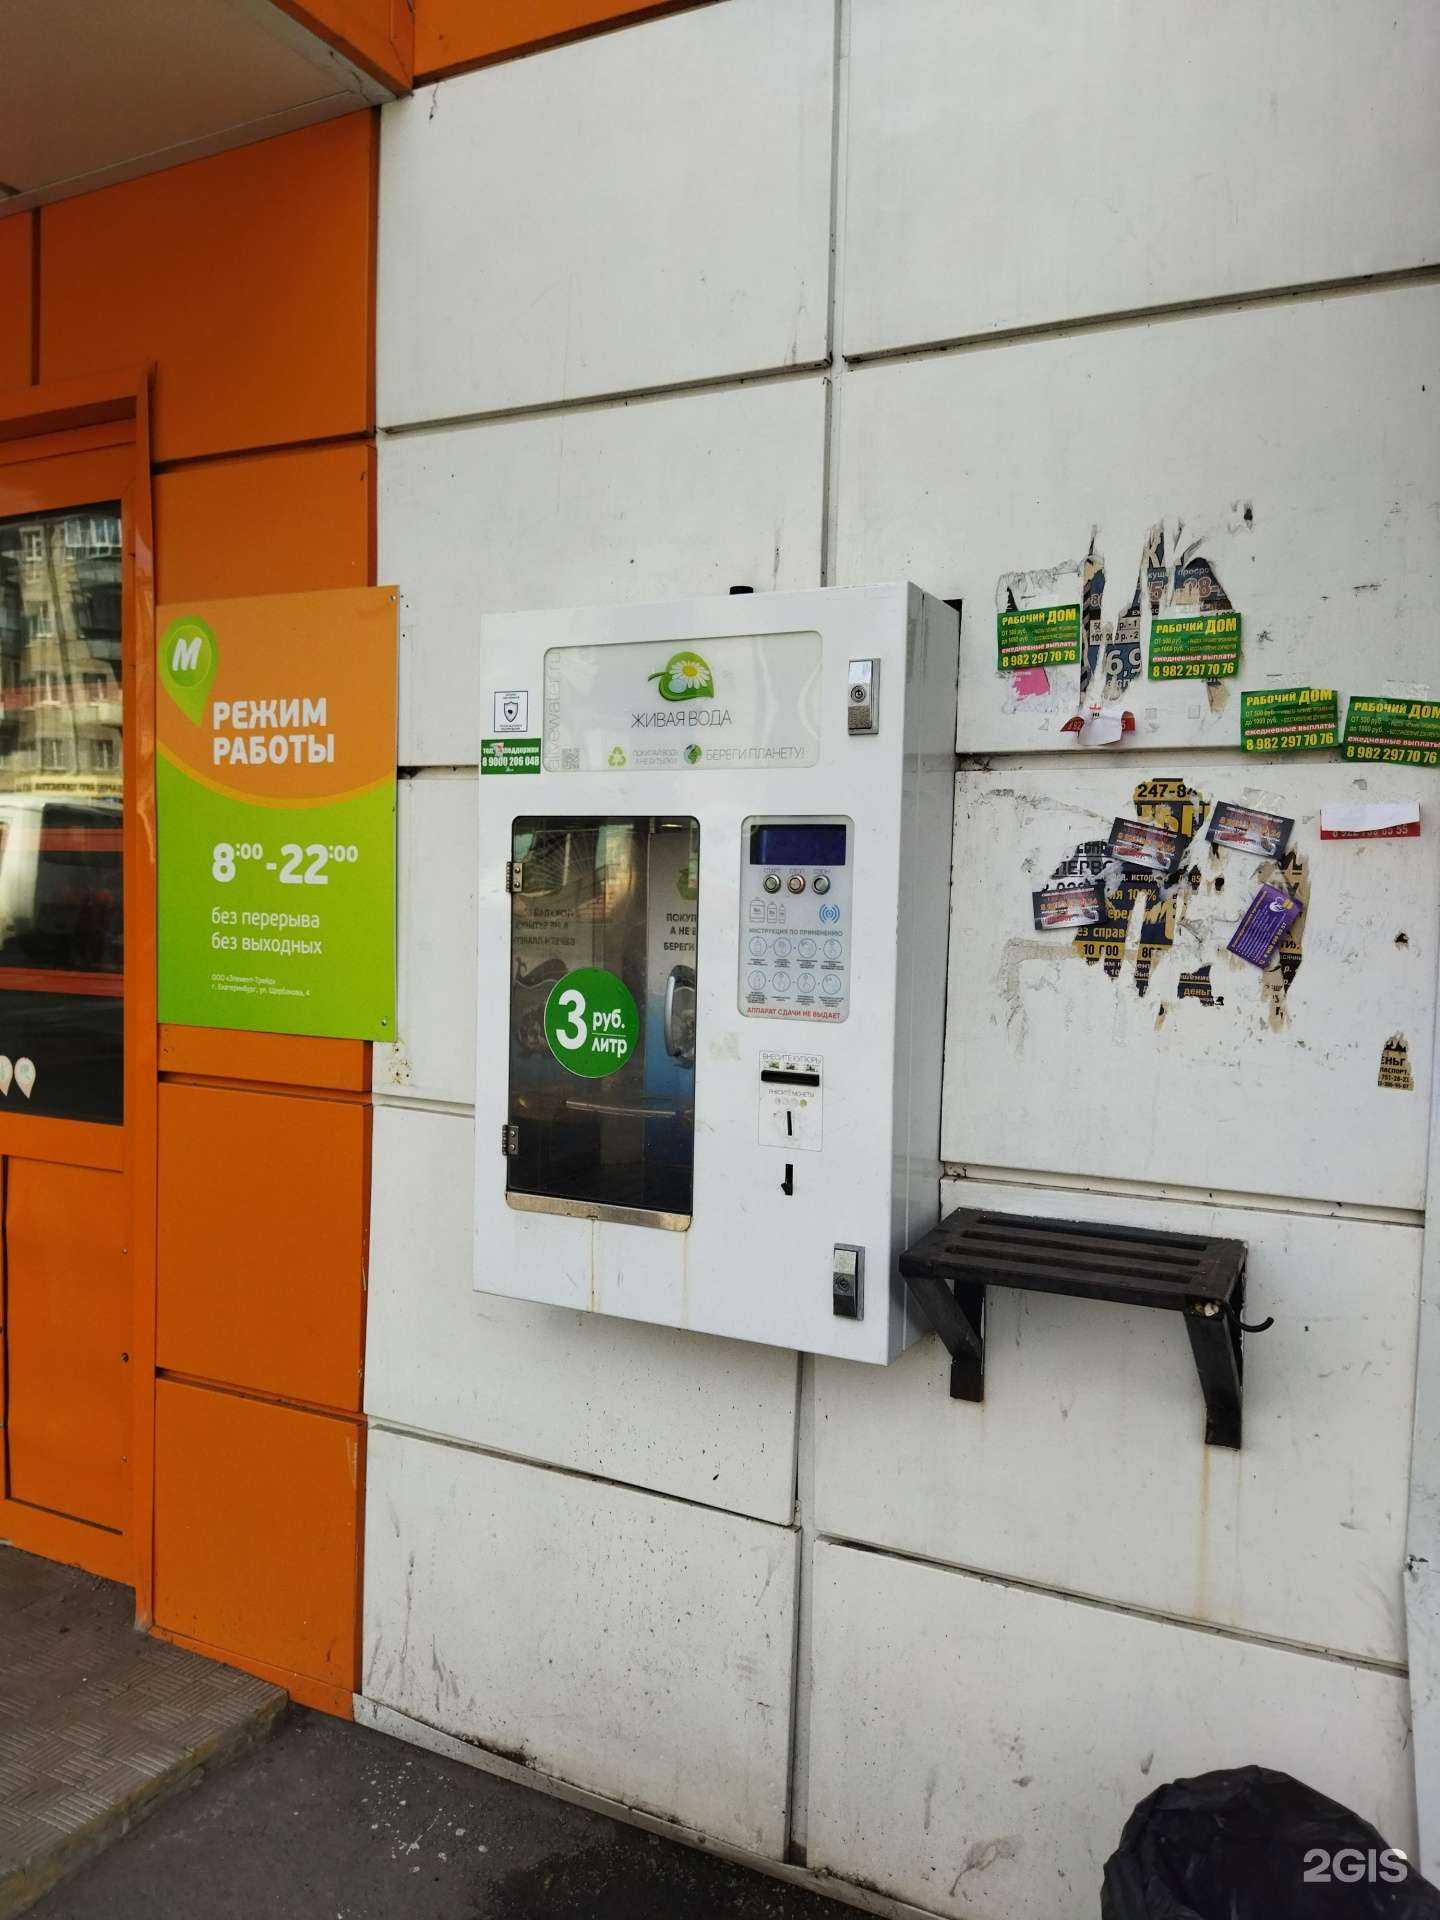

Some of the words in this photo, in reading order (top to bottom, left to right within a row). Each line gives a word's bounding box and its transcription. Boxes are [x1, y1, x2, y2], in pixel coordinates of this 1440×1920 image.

[1002, 612, 1045, 625] РАБОЧИЙ
[1047, 608, 1076, 625] ДОМ
[1156, 622, 1204, 634] РАБОЧИЙ
[1205, 618, 1236, 635] ДОМ
[1002, 656, 1009, 667] 8
[1011, 654, 1029, 666] 982
[1031, 652, 1048, 665] 297
[1064, 649, 1076, 661] 76
[1202, 652, 1236, 661] выплаты
[1153, 666, 1160, 677] 8
[1162, 665, 1183, 677] 982
[1185, 664, 1205, 676] 297
[1207, 664, 1220, 675] 70
[1222, 663, 1235, 674] 76
[1246, 692, 1296, 706] РАБОЧИЙ
[1298, 688, 1332, 705] ДОМ
[213, 698, 328, 730] РЕЖИМ
[1354, 702, 1408, 714] РАБОЧИЙ
[632, 711, 685, 728] ЖИВАЯ
[688, 709, 733, 727] ВОДА
[1245, 727, 1297, 736] ежедневные
[1298, 723, 1336, 732] выплаты
[1246, 739, 1253, 751] 8
[1255, 737, 1278, 750] 982
[1280, 736, 1301, 748] 297
[1304, 734, 1317, 746] 70
[1320, 732, 1333, 745] 76
[1347, 736, 1402, 745] ежедневные
[213, 734, 334, 766] РАБОТЫ
[706, 749, 745, 761] БЕРЕГИ
[749, 747, 806, 760] ПЛАНЕТУ!
[1346, 746, 1354, 758] 8
[1357, 747, 1381, 759] 982
[1382, 748, 1405, 761] 297
[1407, 750, 1421, 762] 70
[1423, 752, 1437, 764] 76
[482, 757, 488, 767] 8
[212, 907, 237, 925] без
[242, 910, 320, 932] перерыва
[670, 926, 677, 935] А
[678, 926, 690, 935] НЕ
[790, 928, 799, 936] ПО
[212, 934, 237, 953] без
[242, 936, 323, 956] выходных
[556, 989, 588, 1050] 3
[592, 1009, 625, 1031] руб.
[747, 1007, 776, 1015] АППАРАТ
[777, 1008, 800, 1017] СДАЧИ
[802, 1009, 812, 1017] НЕ
[812, 1010, 840, 1019] ВЫДАЕТ
[592, 1036, 627, 1058] литр
